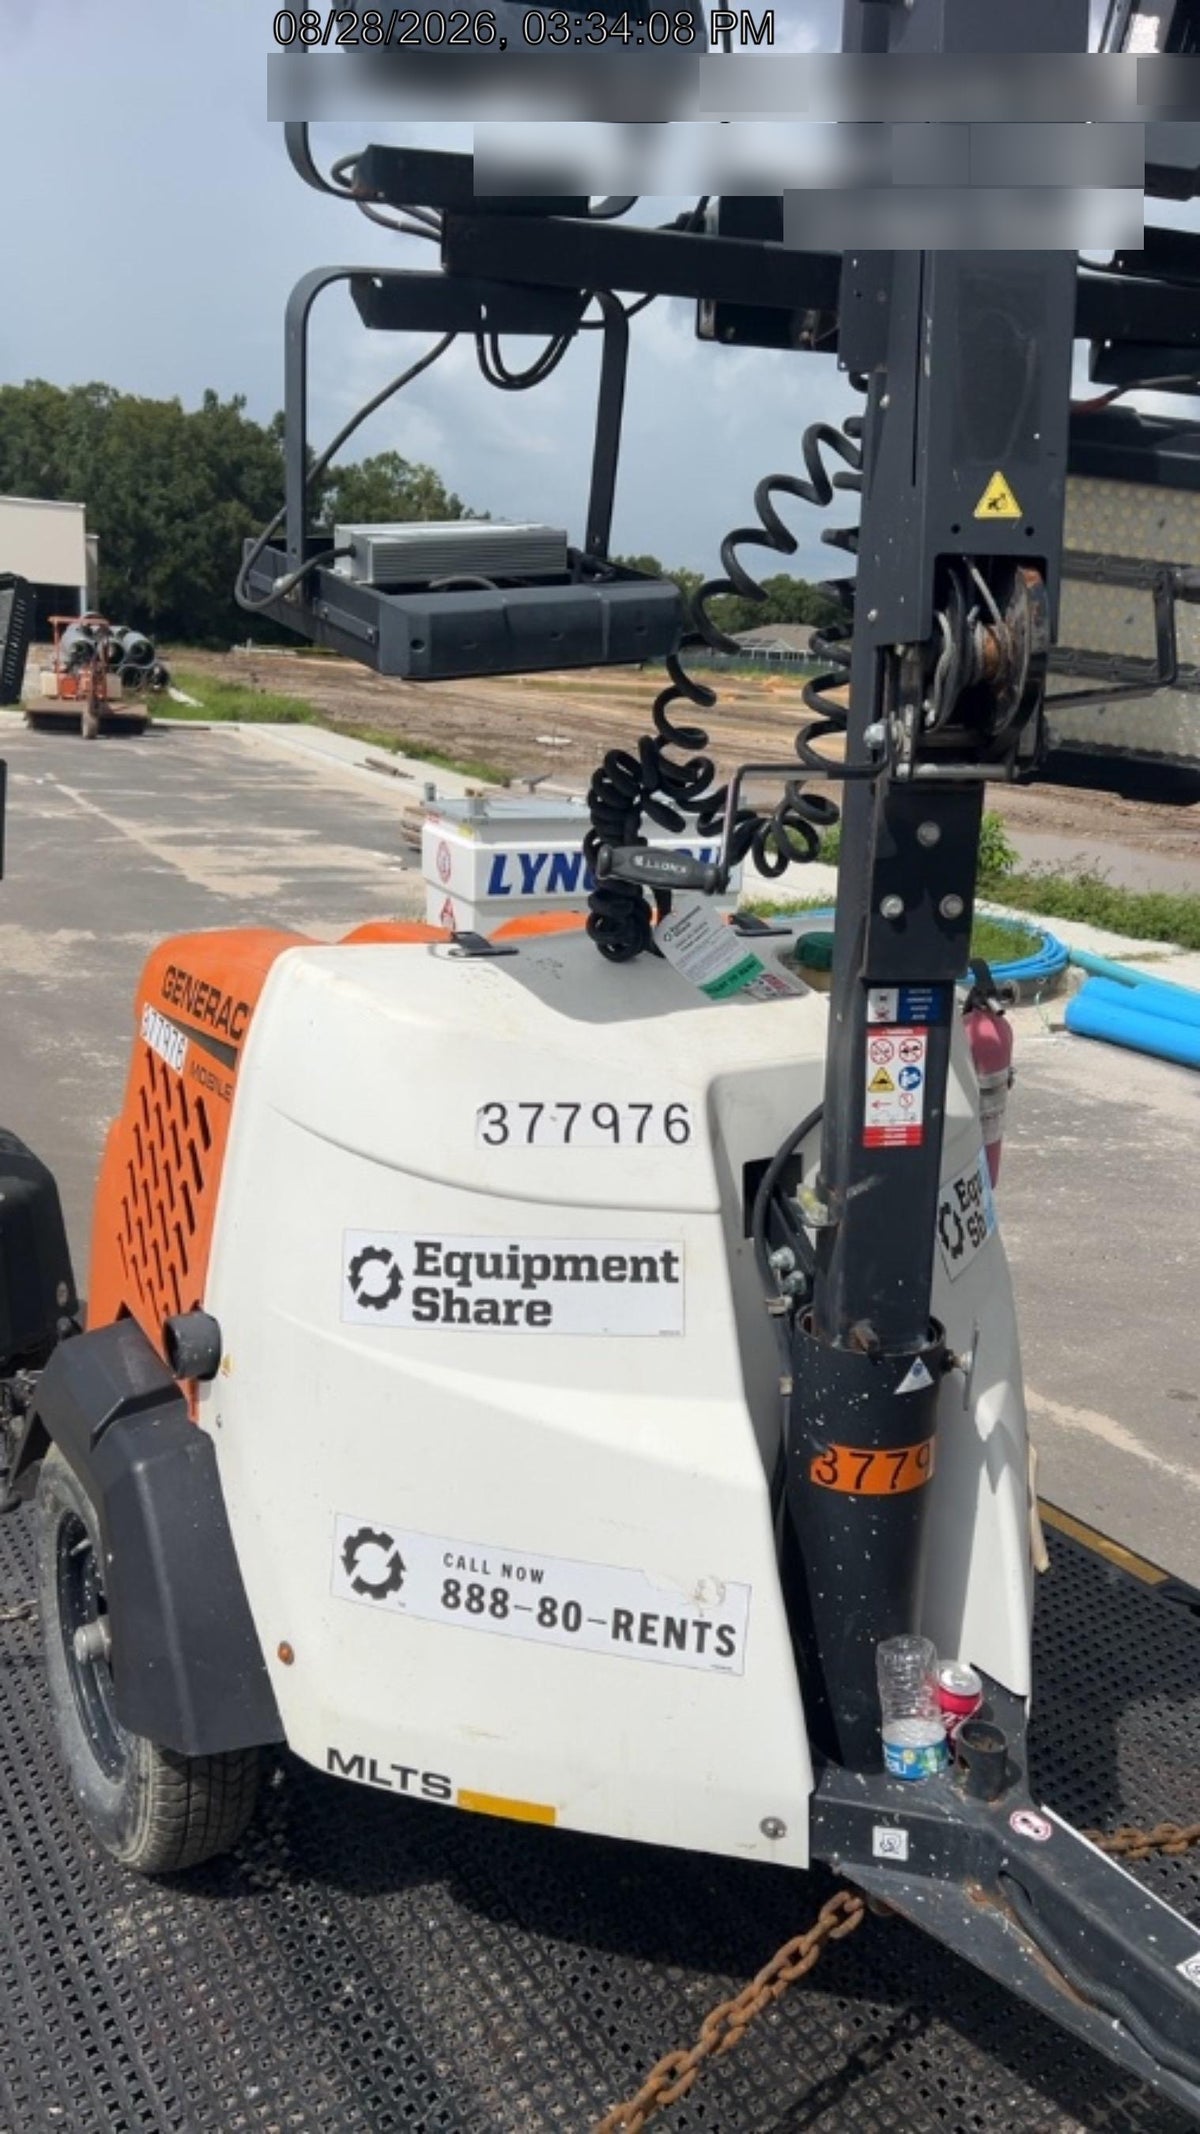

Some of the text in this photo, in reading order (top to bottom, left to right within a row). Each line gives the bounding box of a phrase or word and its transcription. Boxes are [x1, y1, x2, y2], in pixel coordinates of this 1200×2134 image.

[162, 964, 249, 1040] GENERAC
[482, 1102, 691, 1146] 377976
[413, 1241, 680, 1290] Equipment
[411, 1286, 554, 1327] Share
[443, 1552, 545, 1584] CALL NOW
[441, 1579, 738, 1658] 888-80-RENTS
[326, 1746, 453, 1801] MLTS
